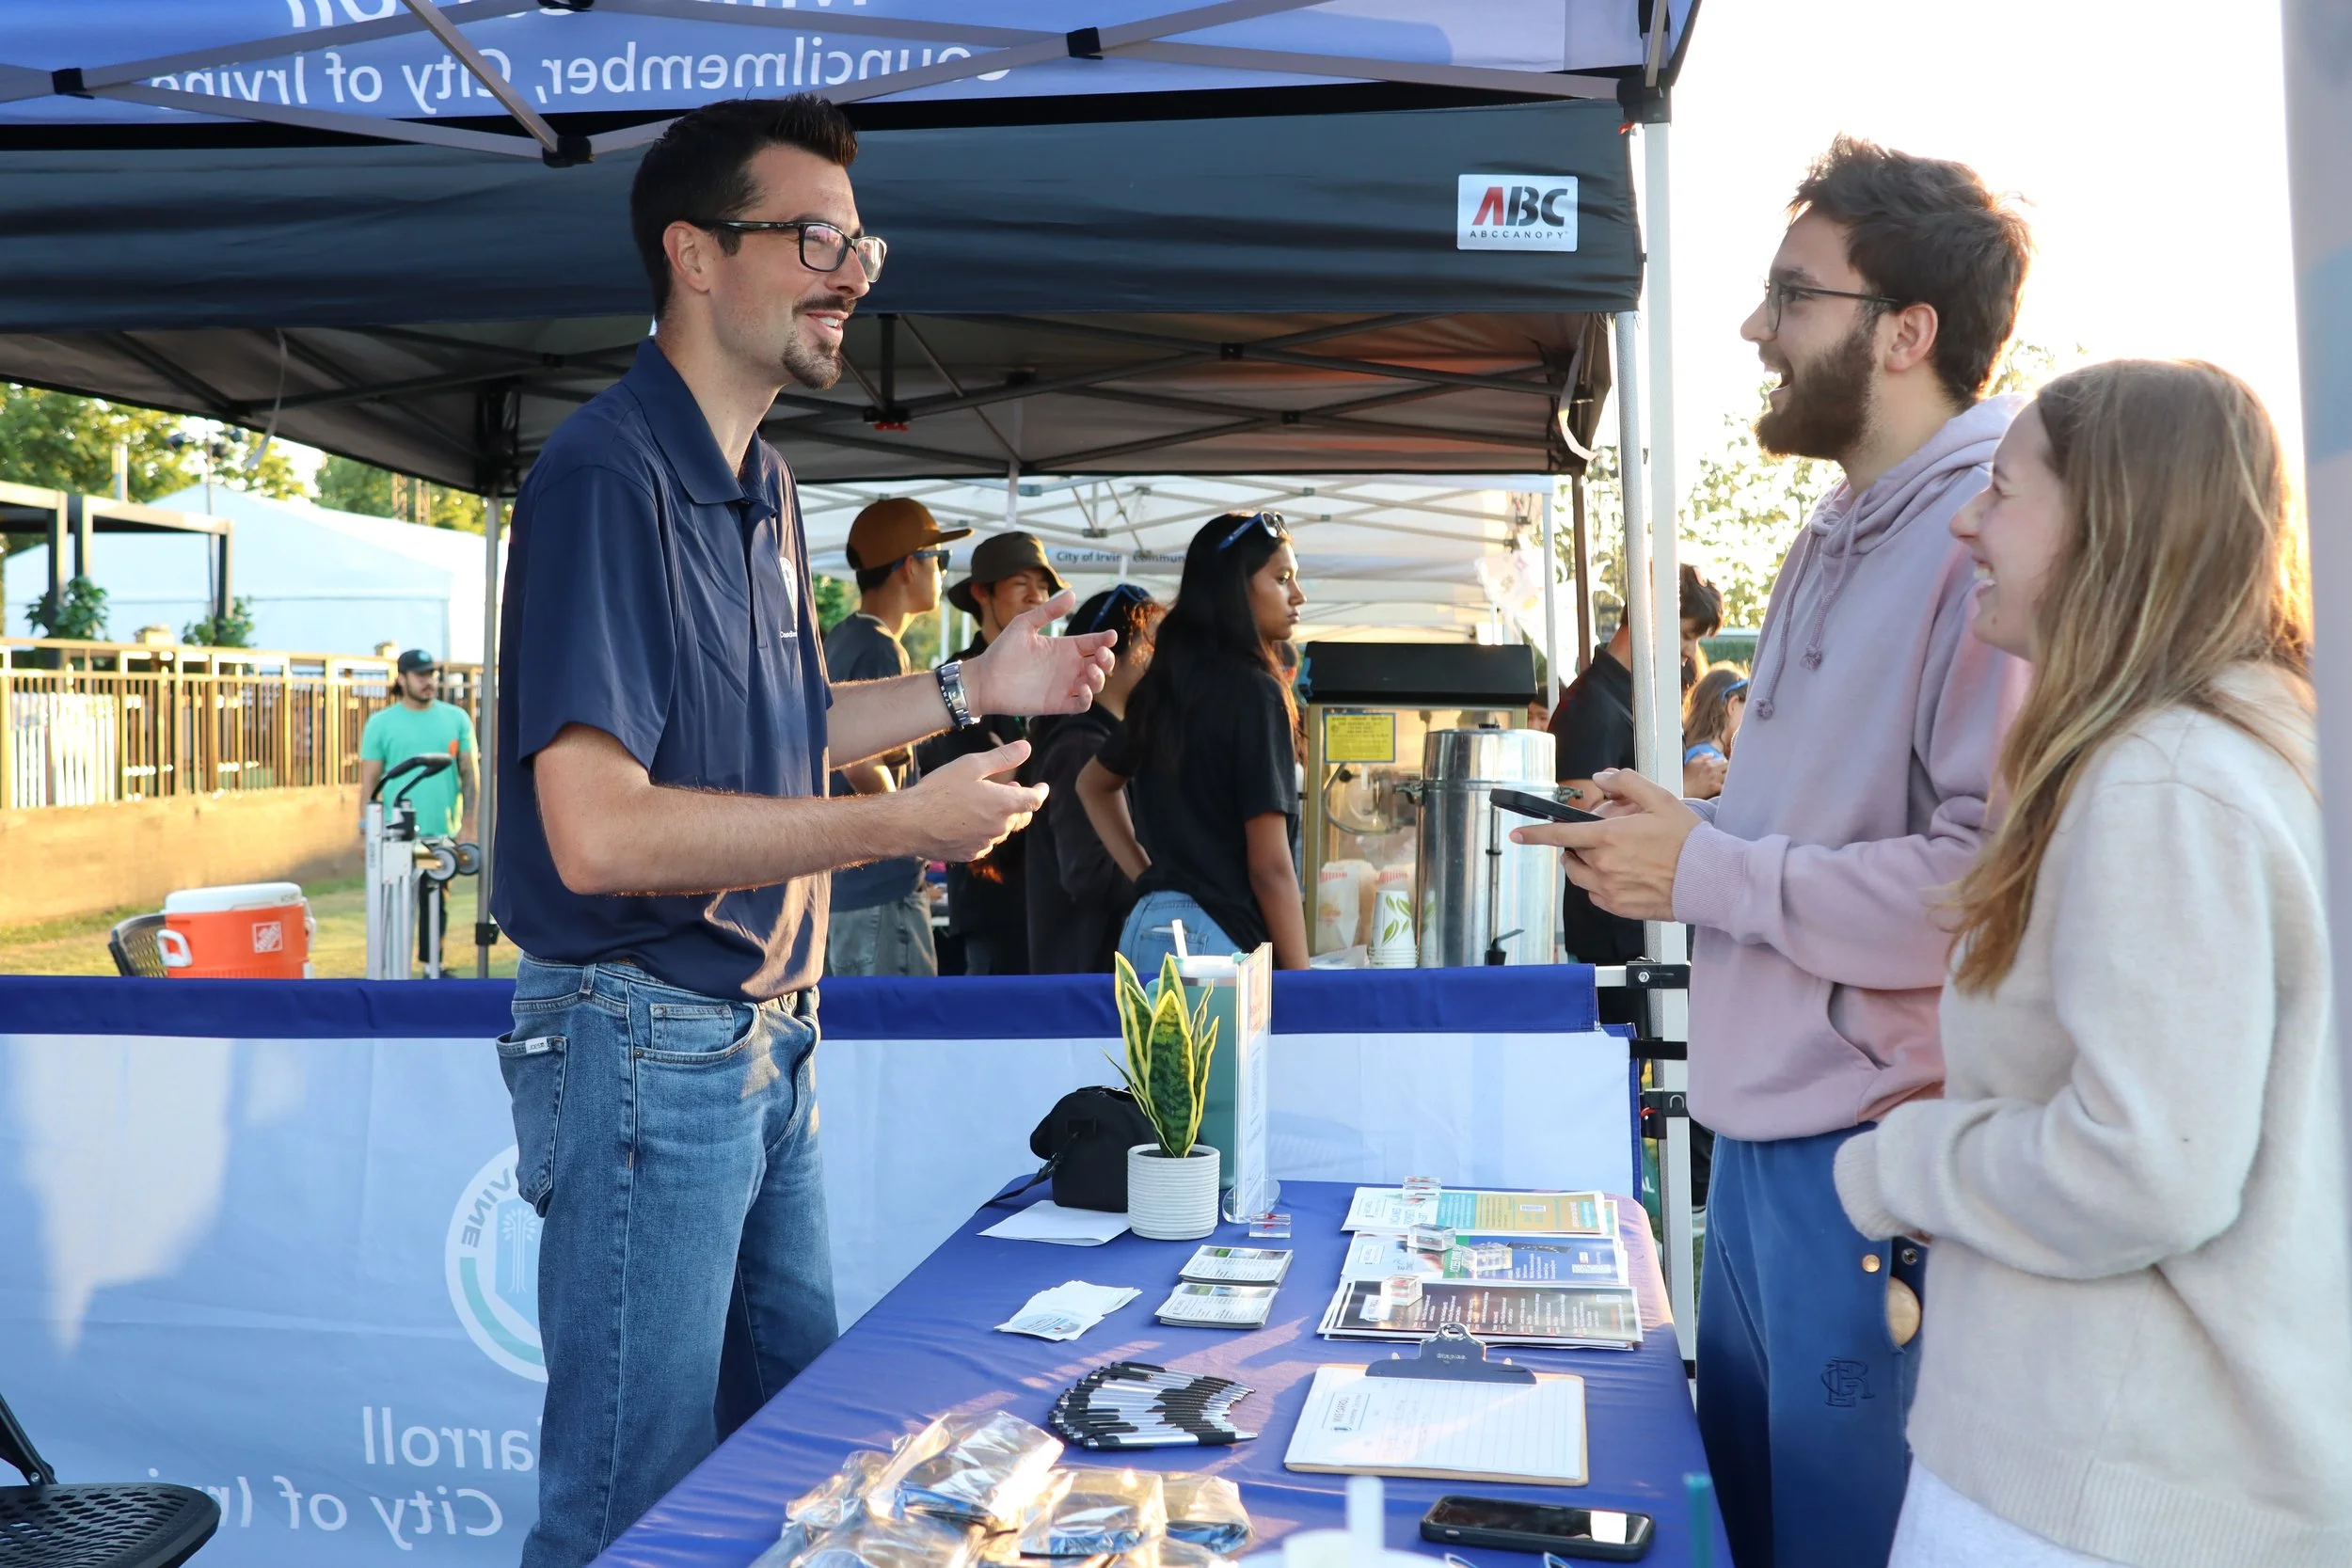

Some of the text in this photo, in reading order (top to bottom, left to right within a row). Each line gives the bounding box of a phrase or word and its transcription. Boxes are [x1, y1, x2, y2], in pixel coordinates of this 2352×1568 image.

[1471, 186, 1568, 227] ABC
[1470, 230, 1564, 240] ABCCANOPY
[1057, 551, 1078, 563] City
[1083, 551, 1094, 562] of
